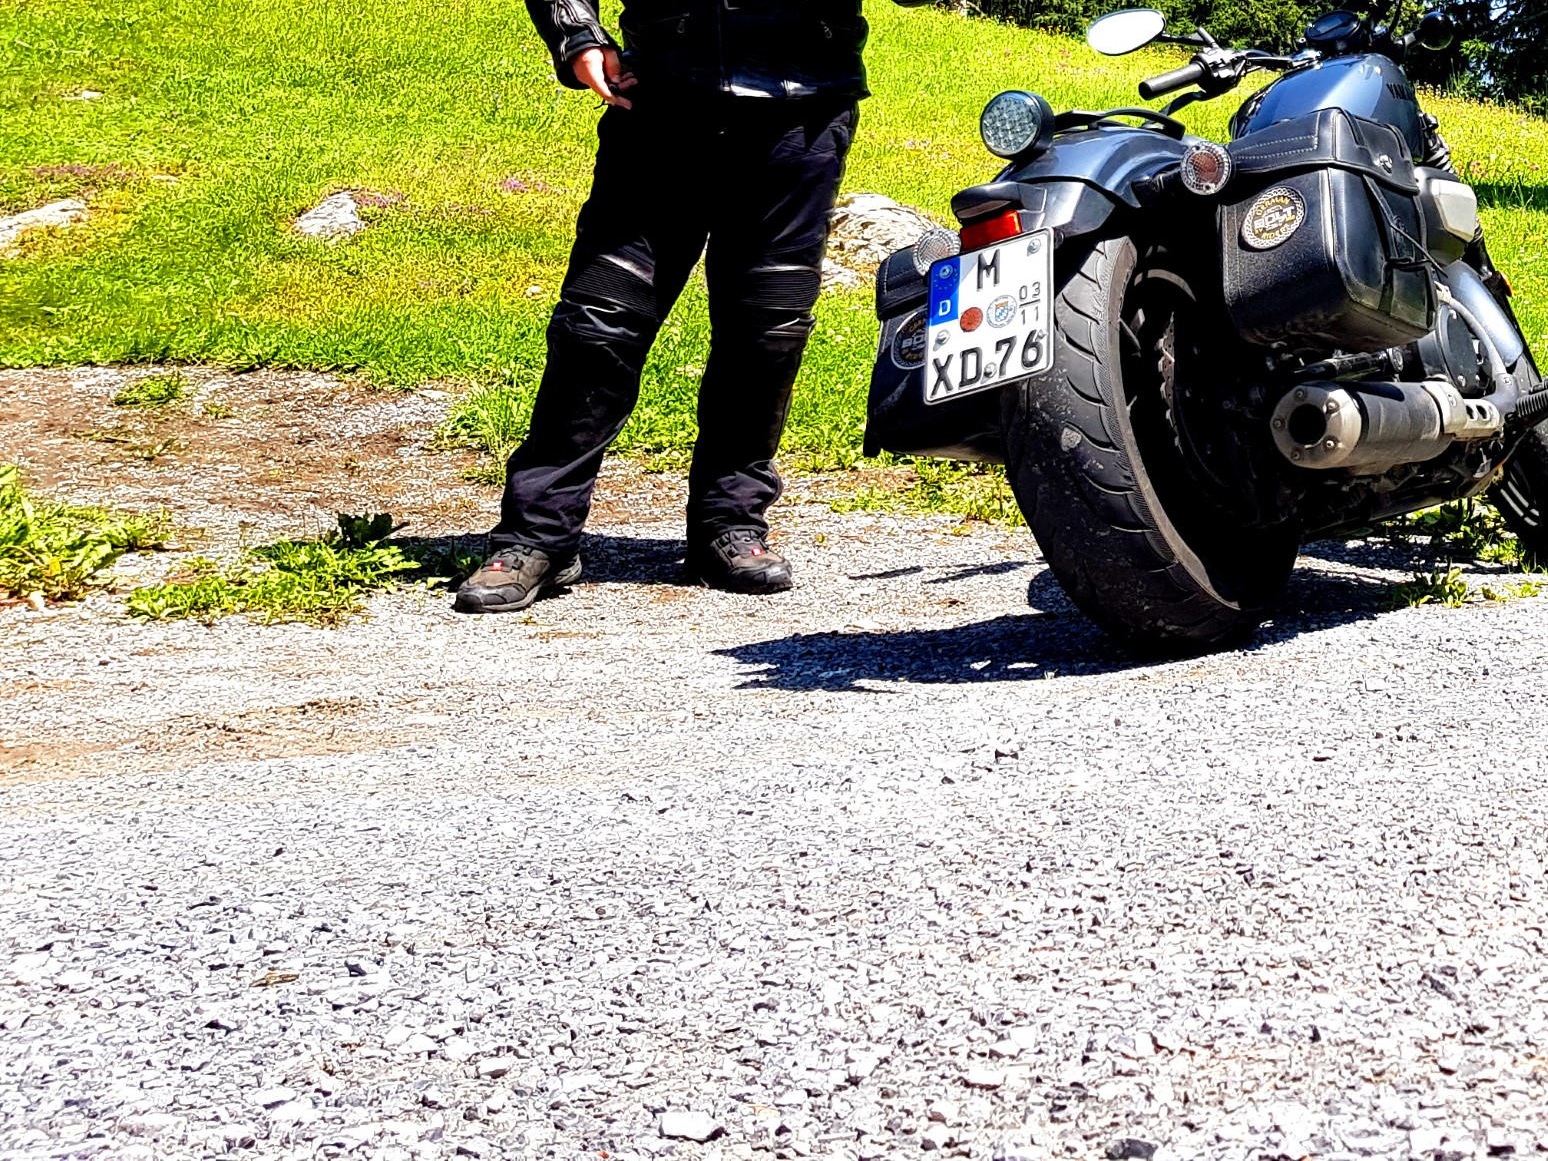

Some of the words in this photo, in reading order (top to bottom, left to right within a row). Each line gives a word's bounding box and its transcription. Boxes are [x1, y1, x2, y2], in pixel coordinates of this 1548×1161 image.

[1253, 205, 1295, 231] BOLT
[976, 248, 1001, 292] M
[1019, 281, 1041, 302] 03
[938, 299, 952, 317] D
[1021, 305, 1039, 325] 11
